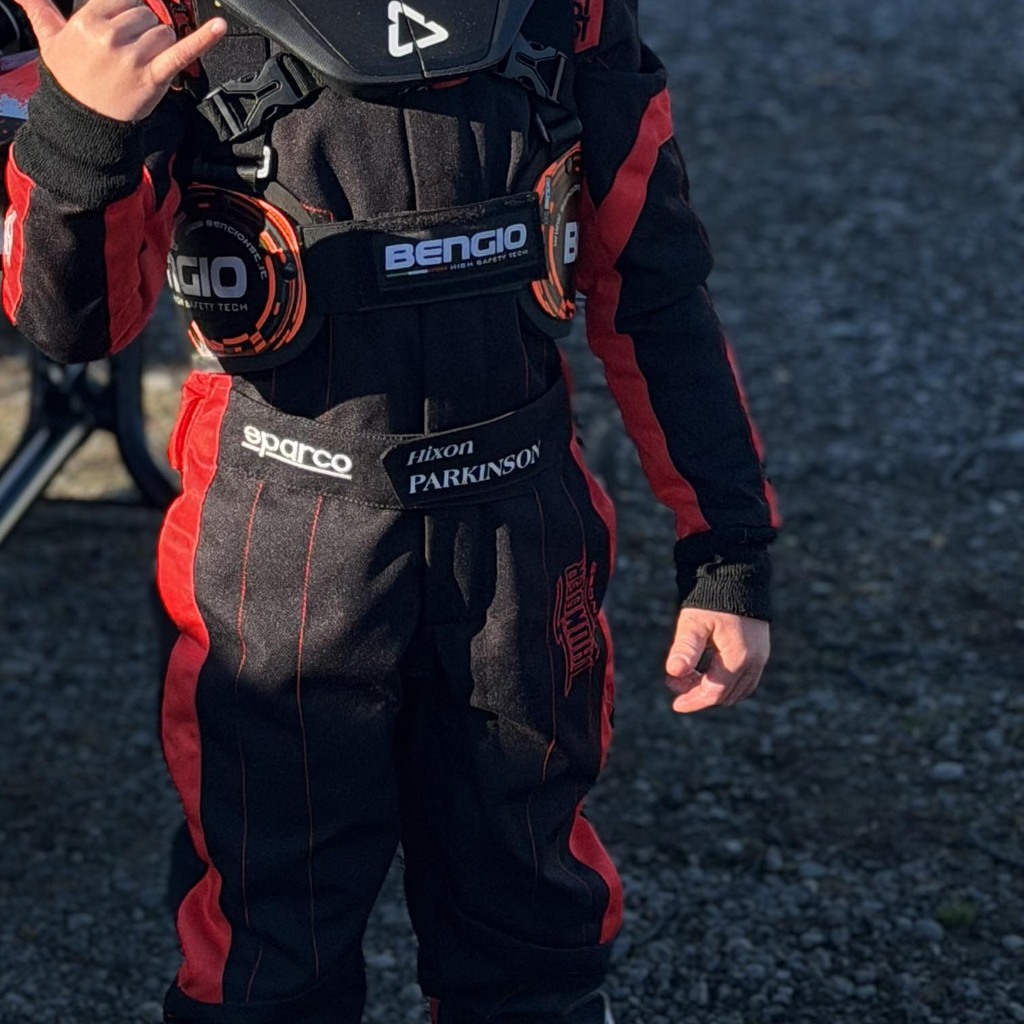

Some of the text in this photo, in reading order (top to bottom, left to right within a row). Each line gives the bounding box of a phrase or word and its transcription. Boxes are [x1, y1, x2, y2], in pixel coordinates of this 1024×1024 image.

[385, 223, 527, 271] BENGIO
[217, 302, 248, 312] TECH
[241, 424, 353, 480] sparco
[406, 439, 474, 466] Hixon
[409, 439, 542, 495] PARKINSON
